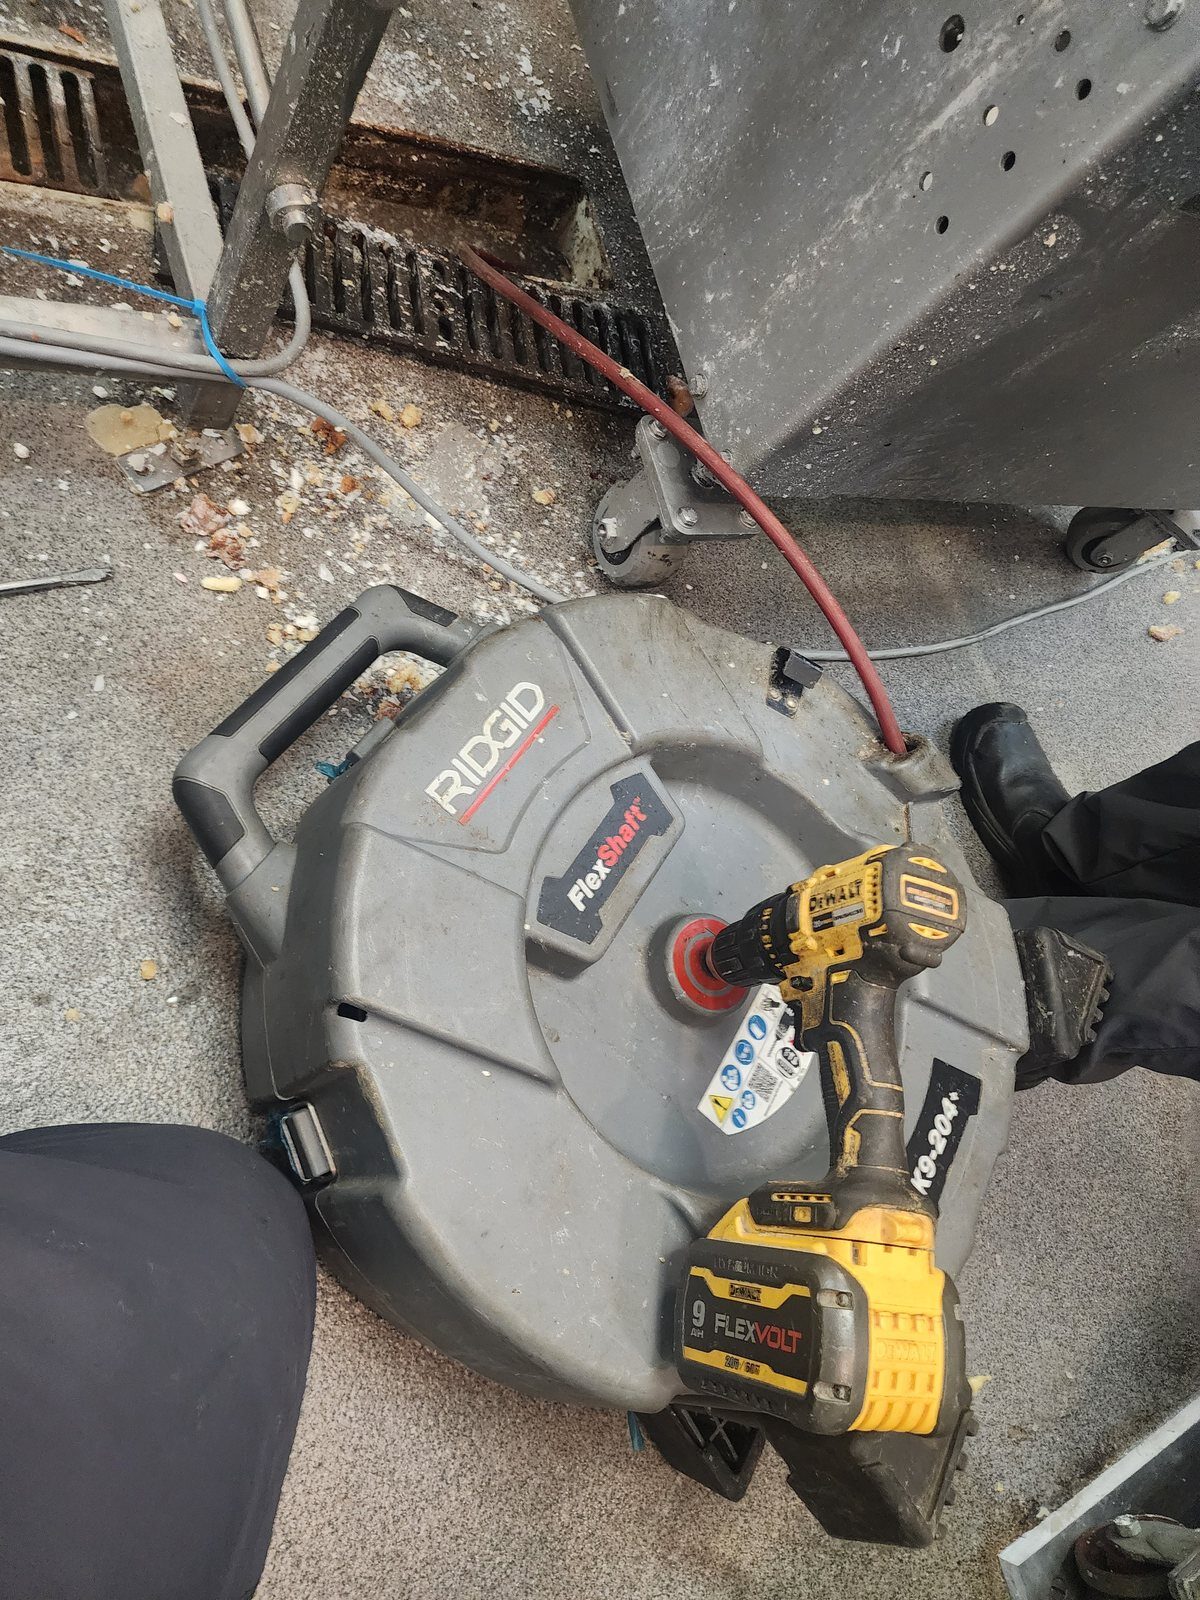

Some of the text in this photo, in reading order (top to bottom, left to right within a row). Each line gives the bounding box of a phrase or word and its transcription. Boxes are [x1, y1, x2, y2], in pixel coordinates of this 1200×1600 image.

[424, 681, 545, 815] RIDGID
[567, 803, 647, 912] FlexShaft
[692, 1299, 706, 1328] 9
[714, 1312, 802, 1354] FLEXVOLT
